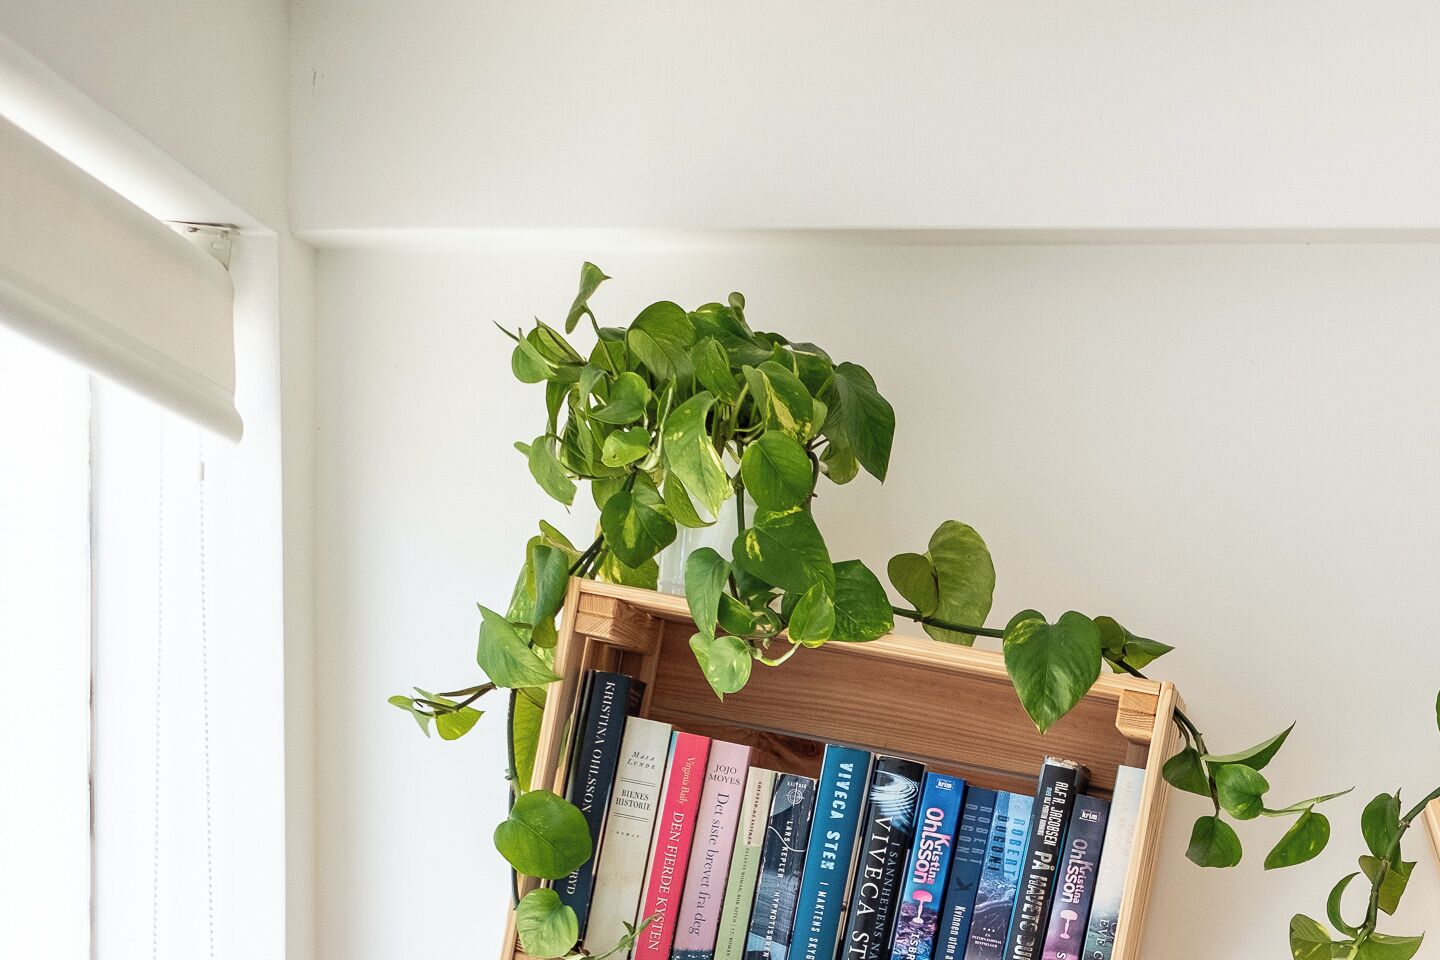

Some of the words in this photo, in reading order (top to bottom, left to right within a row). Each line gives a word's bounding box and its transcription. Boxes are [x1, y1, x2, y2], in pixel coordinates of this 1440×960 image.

[593, 680, 616, 745] KRISTINA
[580, 748, 603, 813] OHLSSON
[620, 789, 649, 801] BIENES
[829, 761, 853, 820] VIVECA
[615, 797, 651, 810] HISTORIE
[711, 792, 729, 817] Det
[667, 811, 685, 842] DEN
[706, 818, 724, 846] siste
[912, 806, 945, 884] Ohlsson
[1002, 817, 1025, 876] ROBERT
[657, 844, 679, 894] FJERDE
[698, 848, 719, 888] brevet
[819, 830, 840, 870] STEN
[855, 814, 892, 918] VIVECA
[926, 833, 951, 886] Kristina
[1031, 850, 1054, 871] PÅ
[1060, 837, 1088, 903] Ohlsson
[694, 890, 711, 910] fra
[872, 850, 898, 938] SANNHETENS
[1071, 860, 1093, 904] Kristina
[646, 896, 669, 951] KYSTEN
[689, 912, 707, 936] deg
[809, 890, 827, 933] MAKTENS
[949, 905, 965, 934] Kvinnen
[1094, 918, 1109, 946] EVE
[945, 935, 959, 954] uten
